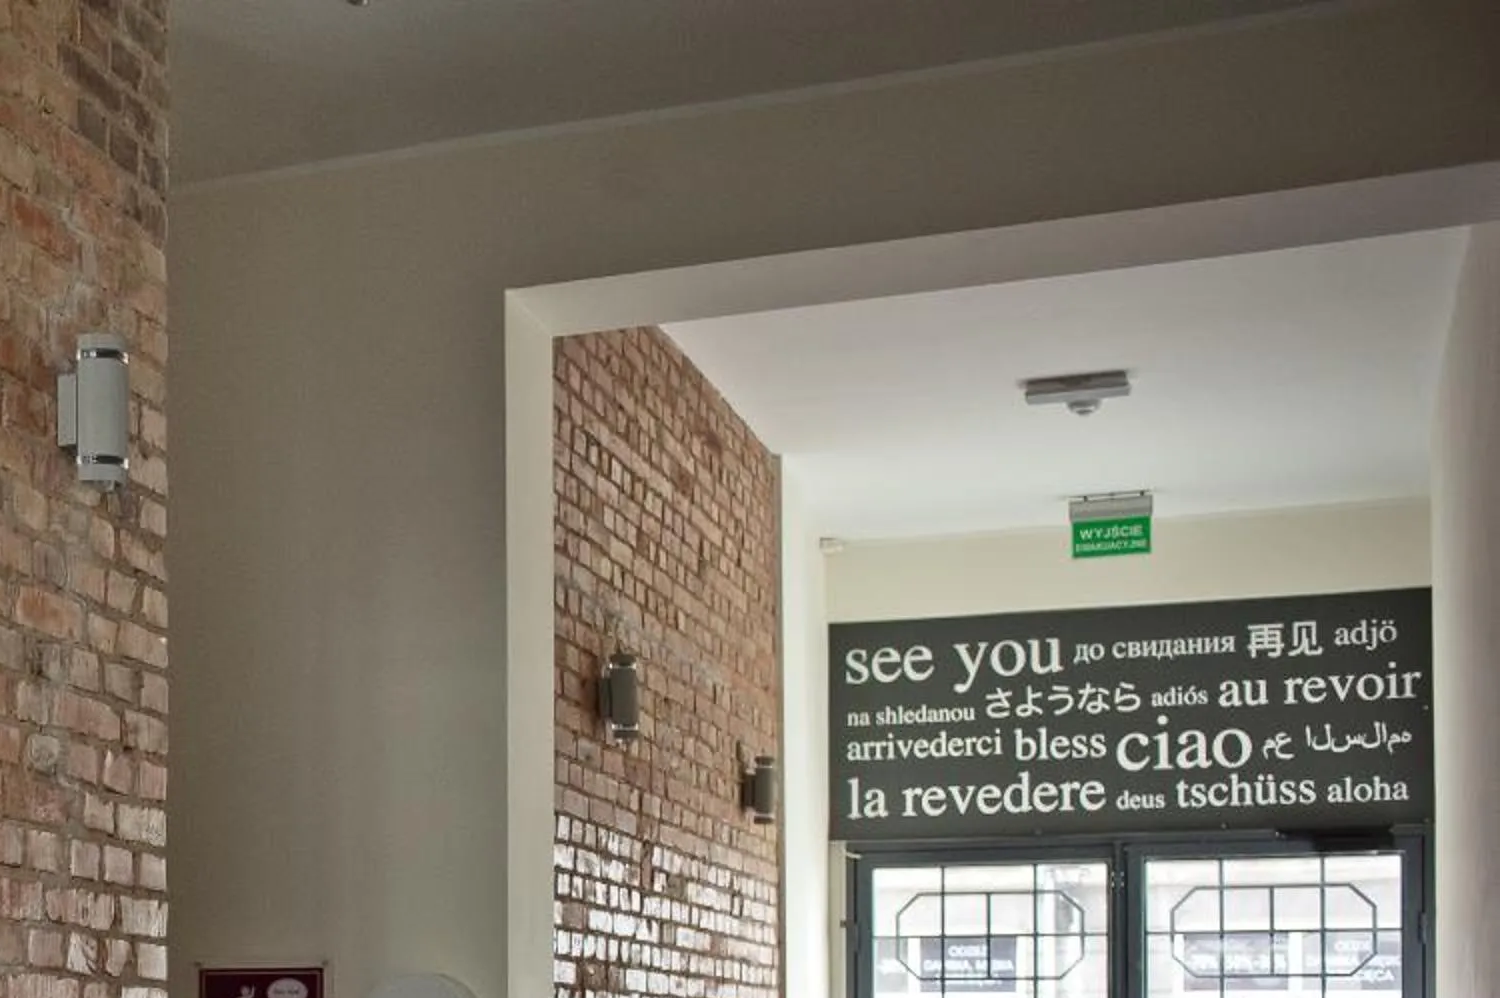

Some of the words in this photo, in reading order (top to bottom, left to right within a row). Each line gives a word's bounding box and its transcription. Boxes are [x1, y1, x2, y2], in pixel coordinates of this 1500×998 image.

[1079, 523, 1144, 541] WYJŚCIE
[1073, 643, 1106, 665] до
[1111, 635, 1236, 661] свидания
[1247, 620, 1323, 659] 再见
[1334, 619, 1397, 651] adjö
[845, 645, 935, 685] see
[953, 637, 1064, 694] you
[985, 681, 1142, 719] さようなら
[1151, 685, 1209, 708] adiós
[1217, 679, 1269, 708] au
[1283, 661, 1422, 705] revoir
[847, 711, 871, 727] na
[875, 703, 976, 726] shledanou
[846, 730, 1003, 762] arrivederci
[1013, 726, 1107, 761] bless
[1115, 714, 1253, 772] ciao
[847, 776, 890, 821] la
[901, 770, 1107, 818] revedere
[1115, 789, 1166, 811] deus
[1175, 772, 1317, 809] tschüss
[1327, 775, 1409, 803] aloha
